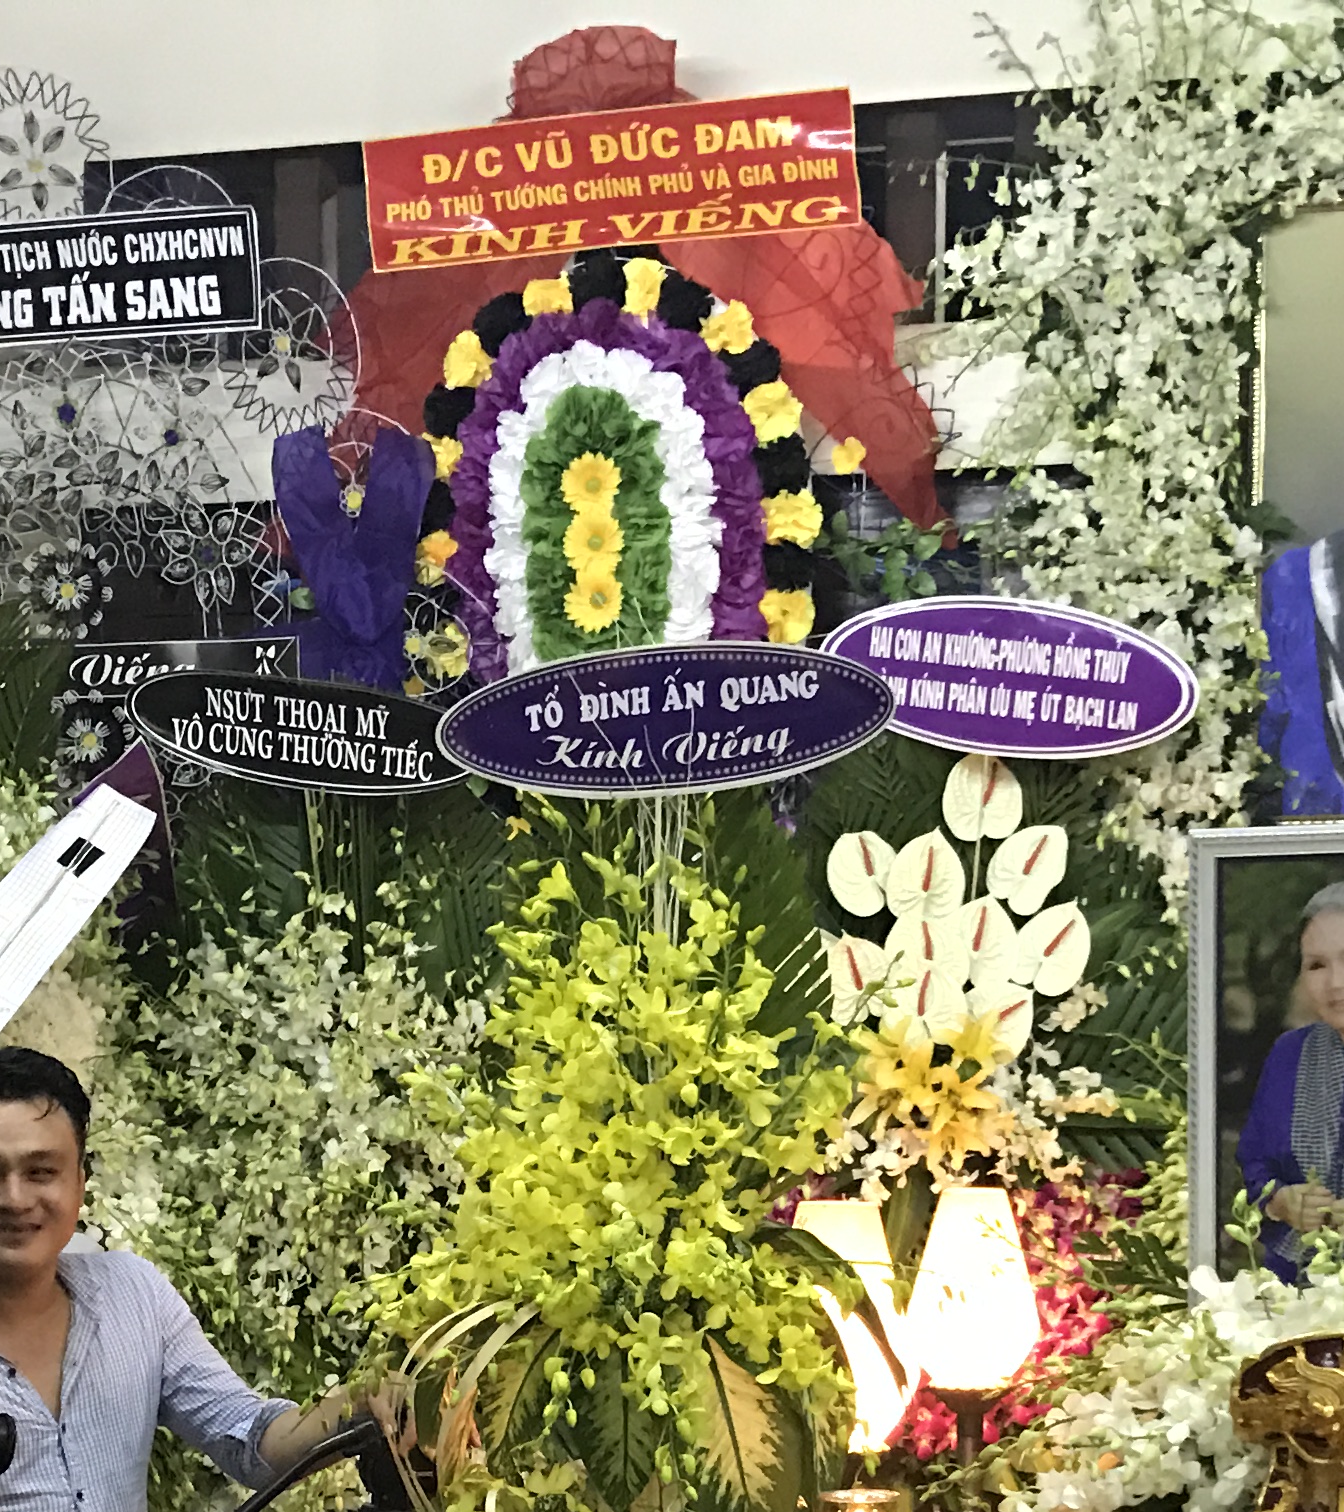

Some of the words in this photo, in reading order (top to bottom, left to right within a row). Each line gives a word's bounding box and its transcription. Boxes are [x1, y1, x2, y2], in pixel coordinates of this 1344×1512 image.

[423, 148, 505, 185] Đ/C
[516, 130, 573, 171] VŨ
[591, 118, 681, 165] ĐỨC
[695, 116, 794, 154] ĐAM
[387, 194, 432, 224] PHÓ
[438, 185, 484, 220] THỦ
[491, 179, 568, 212] TƯỚNG
[574, 170, 643, 203] CHÍNH
[649, 163, 693, 195] PHỦ
[701, 160, 731, 189] VÀ
[739, 161, 777, 187] GIA
[783, 154, 839, 182] ĐÌNH
[607, 192, 849, 241] VIẾNG
[57, 229, 118, 269] NƯỚC
[124, 226, 245, 264] CHXHCNVN
[43, 273, 117, 325] TẤN
[125, 275, 222, 322] SANG
[869, 626, 893, 658] HAI
[894, 628, 921, 661] CON
[922, 632, 941, 664] AN
[356, 704, 391, 740] MỸ
[524, 685, 564, 732] TỔ
[579, 681, 651, 723] ĐÌNH
[661, 666, 706, 713] ẤN
[719, 670, 820, 712] QUANG
[909, 672, 945, 710] KÍNH
[947, 676, 985, 715] PHÂN
[1012, 690, 1036, 725] MẸ
[1041, 685, 1063, 722] ÚT
[1064, 694, 1104, 731] BẠCH
[1108, 701, 1139, 731] LAN
[172, 715, 205, 749] VÔ
[278, 732, 378, 775] THƯƠNG
[381, 738, 434, 782] TIẾC
[535, 734, 646, 770] Kính
[662, 723, 795, 765] Viếng
